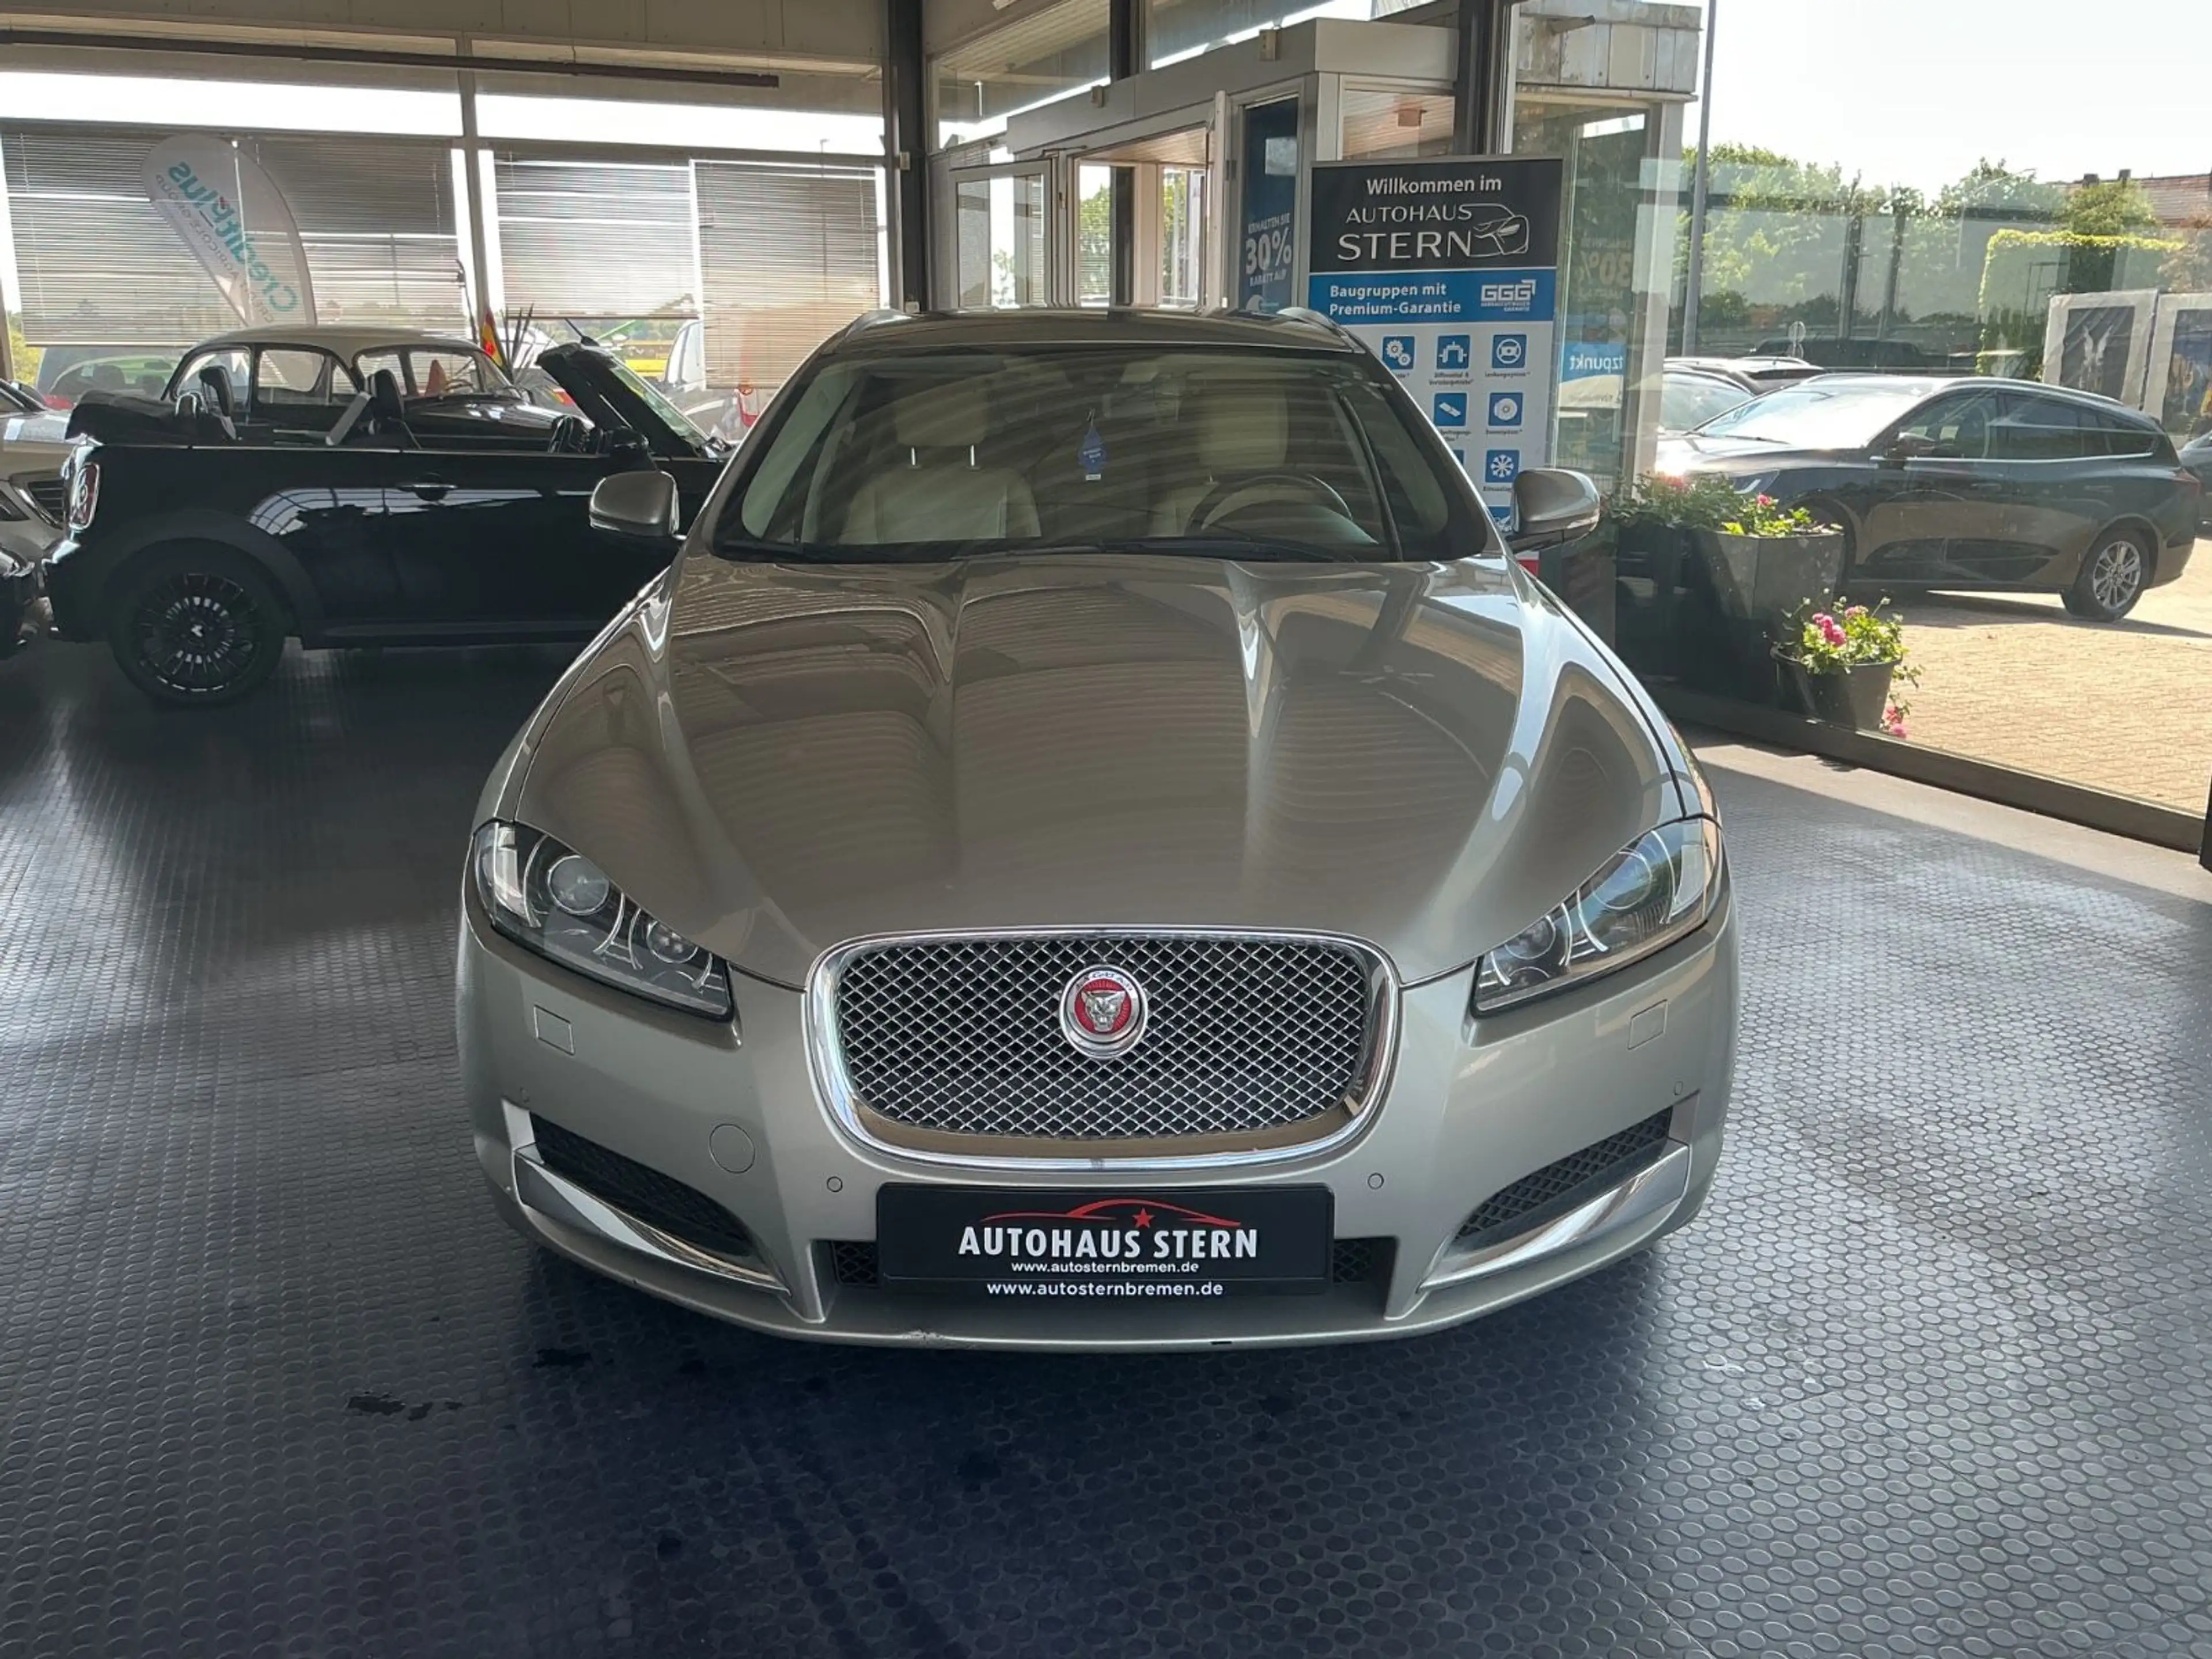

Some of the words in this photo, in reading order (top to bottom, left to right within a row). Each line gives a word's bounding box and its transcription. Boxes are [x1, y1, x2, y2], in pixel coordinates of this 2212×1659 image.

[1366, 177, 1475, 195] Willkommen
[1480, 174, 1502, 191] im
[1345, 204, 1472, 224] AUTOHAUS
[1245, 226, 1292, 275] 30%
[1337, 230, 1471, 260] STERN
[1330, 285, 1418, 300] Baugruppen
[1422, 282, 1447, 296] mit
[1480, 284, 1532, 301] GGG
[1329, 300, 1461, 316] Premium-Garantie
[959, 1226, 1141, 1258] AUTOHAUS
[1153, 1229, 1257, 1259] STERN
[1011, 1262, 1200, 1273] www.autosternbremen.de
[987, 1282, 1224, 1296] www.autosternbremen.de
